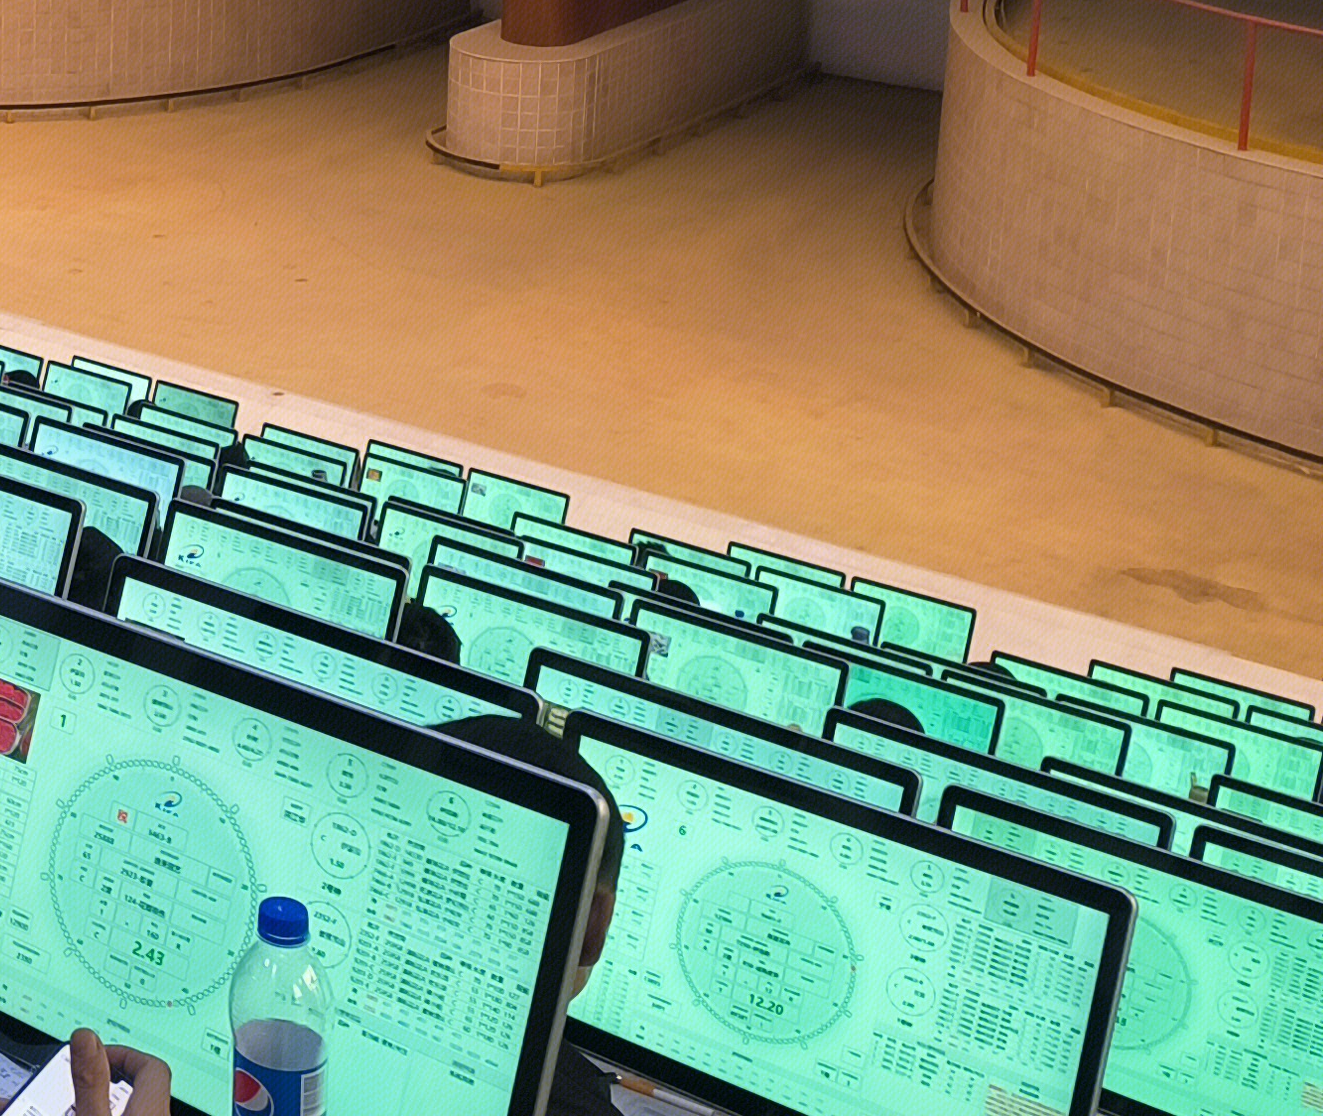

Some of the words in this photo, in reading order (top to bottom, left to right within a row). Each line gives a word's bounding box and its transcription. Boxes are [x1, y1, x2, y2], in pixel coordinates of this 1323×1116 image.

[60, 715, 67, 727] 1
[132, 940, 165, 966] 2.43
[749, 993, 784, 1016] 12.20
